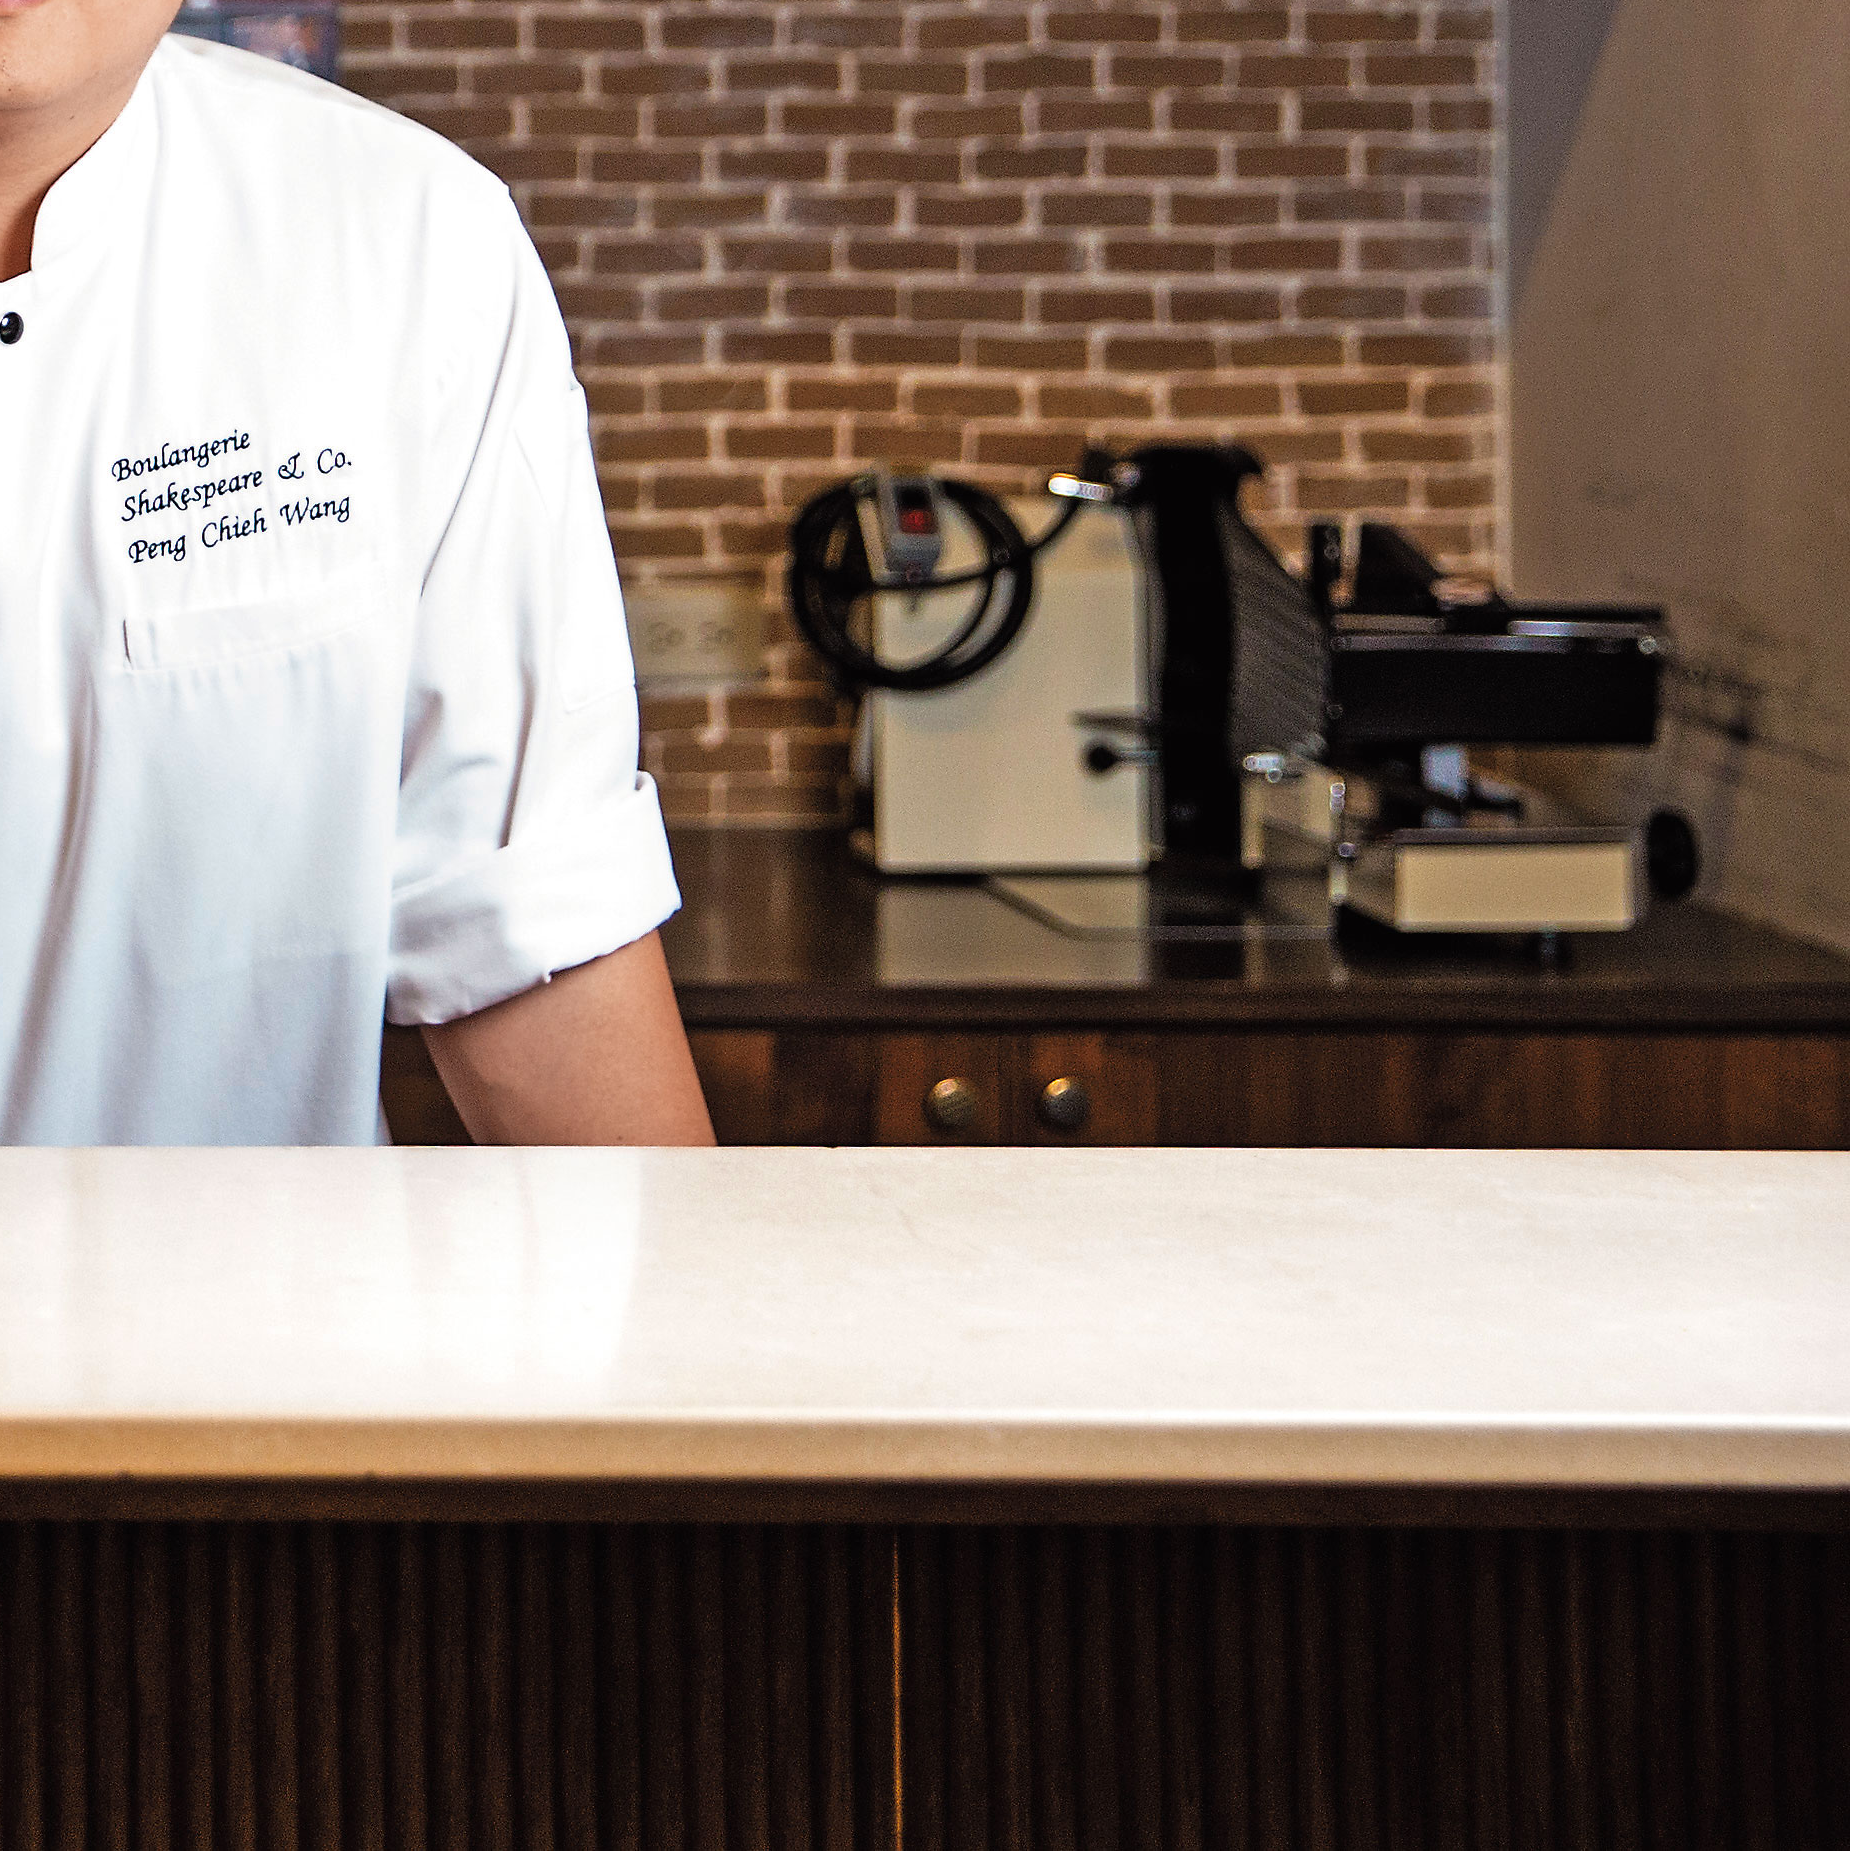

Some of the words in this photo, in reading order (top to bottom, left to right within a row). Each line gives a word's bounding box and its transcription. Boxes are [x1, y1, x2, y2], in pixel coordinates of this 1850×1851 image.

[111, 429, 251, 482] Boulangerie
[121, 469, 264, 522] Shakespeare
[278, 452, 305, 480] &
[317, 448, 353, 475] Co.
[128, 534, 187, 564] Peng
[201, 508, 268, 548] Chieh
[280, 496, 351, 525] Wang
